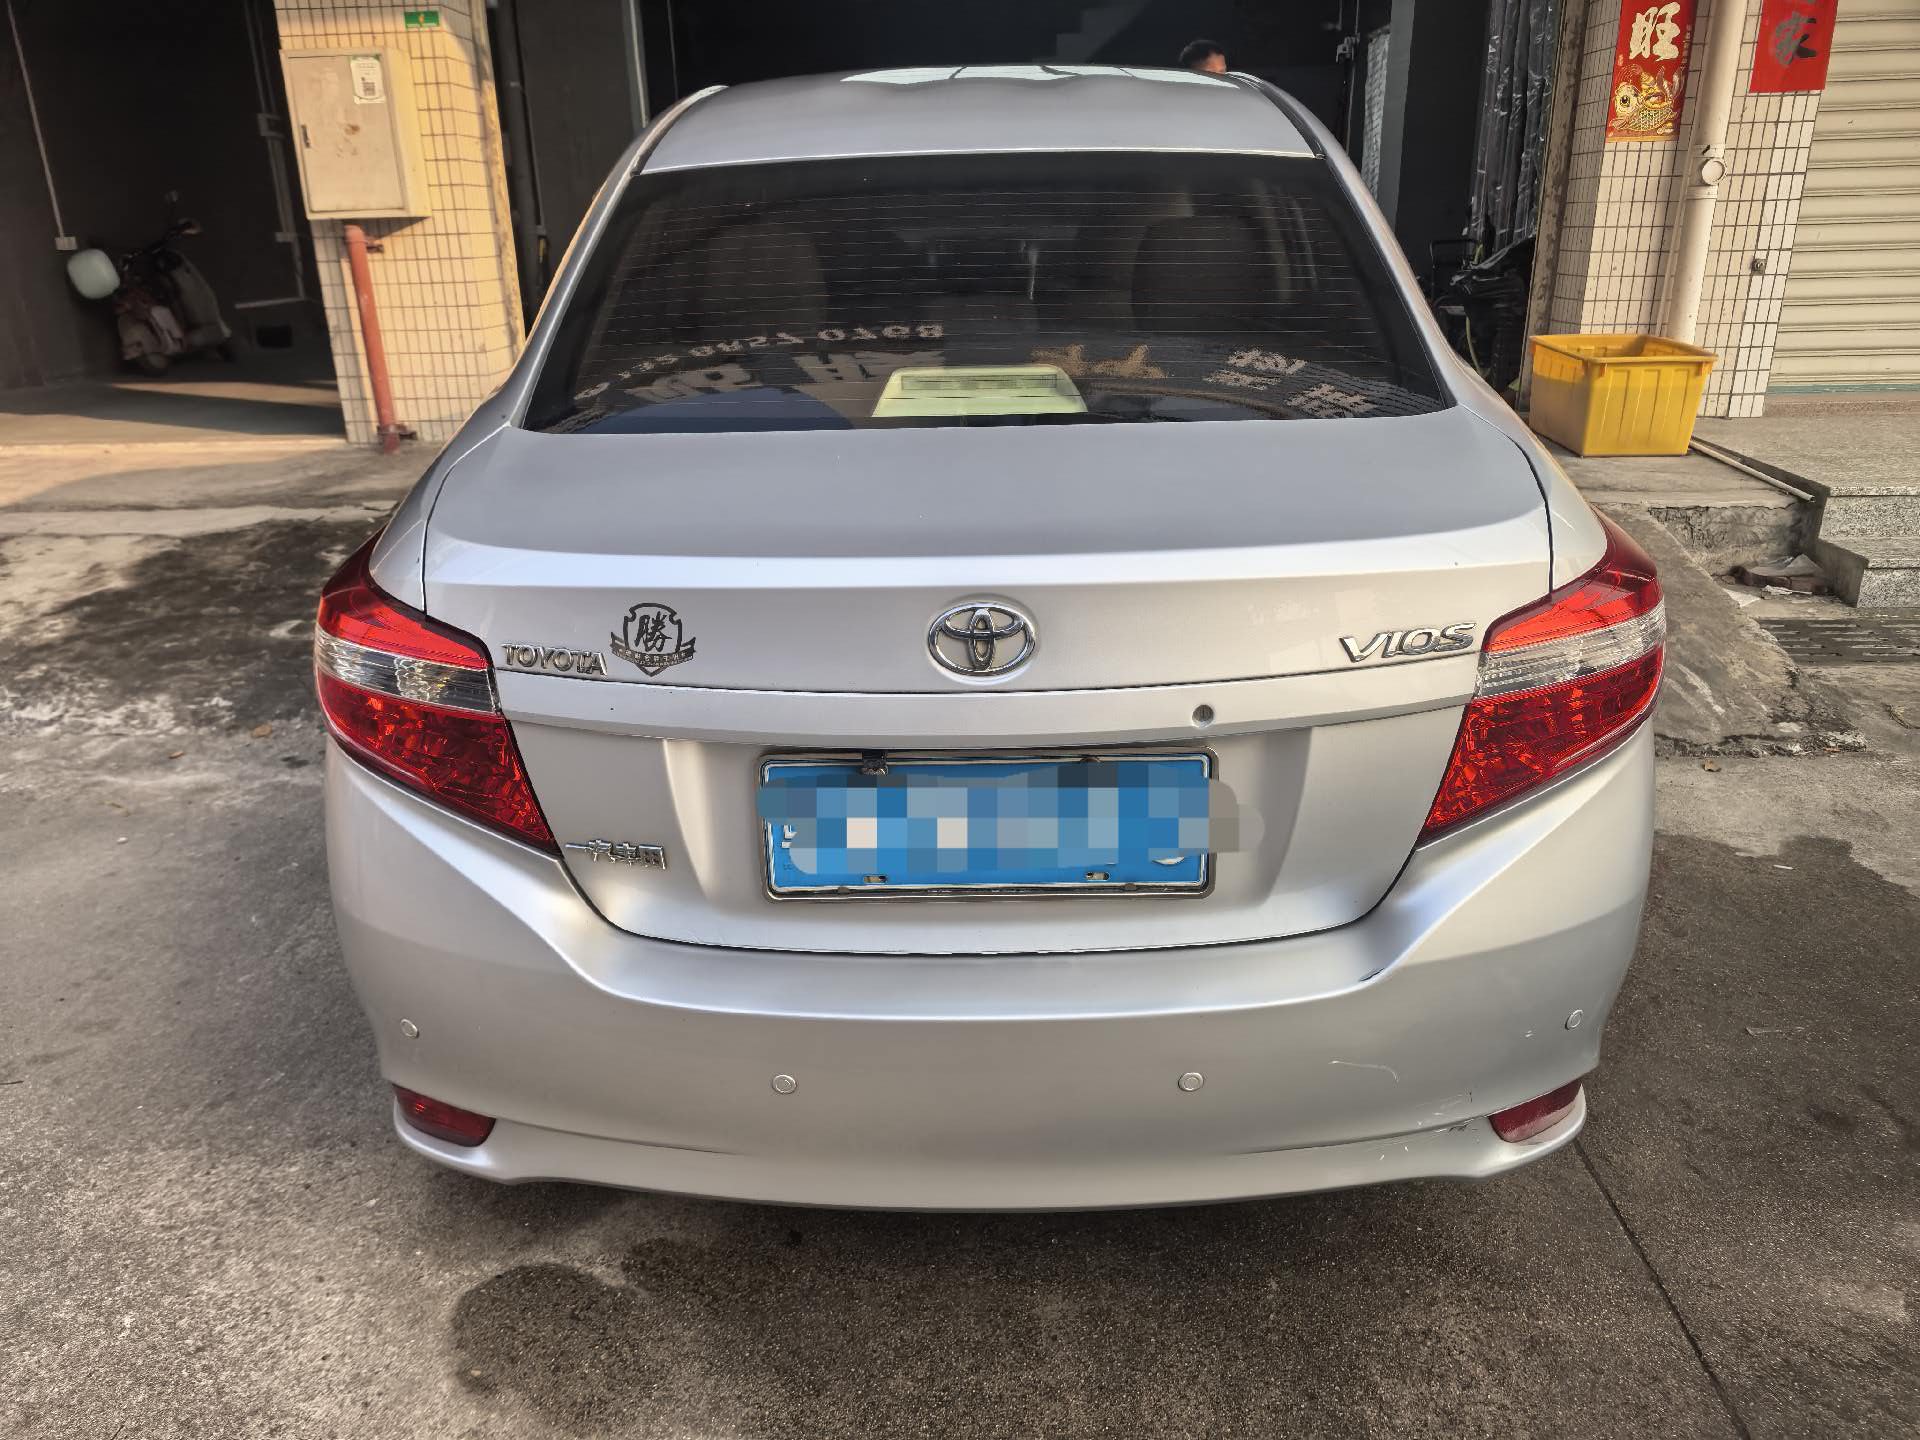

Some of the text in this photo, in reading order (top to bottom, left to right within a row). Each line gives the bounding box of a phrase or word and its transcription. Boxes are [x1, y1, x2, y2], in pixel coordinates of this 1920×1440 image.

[1627, 1, 1680, 61] 旺
[502, 643, 608, 676] TOYOTA
[1339, 622, 1477, 663] VIOS
